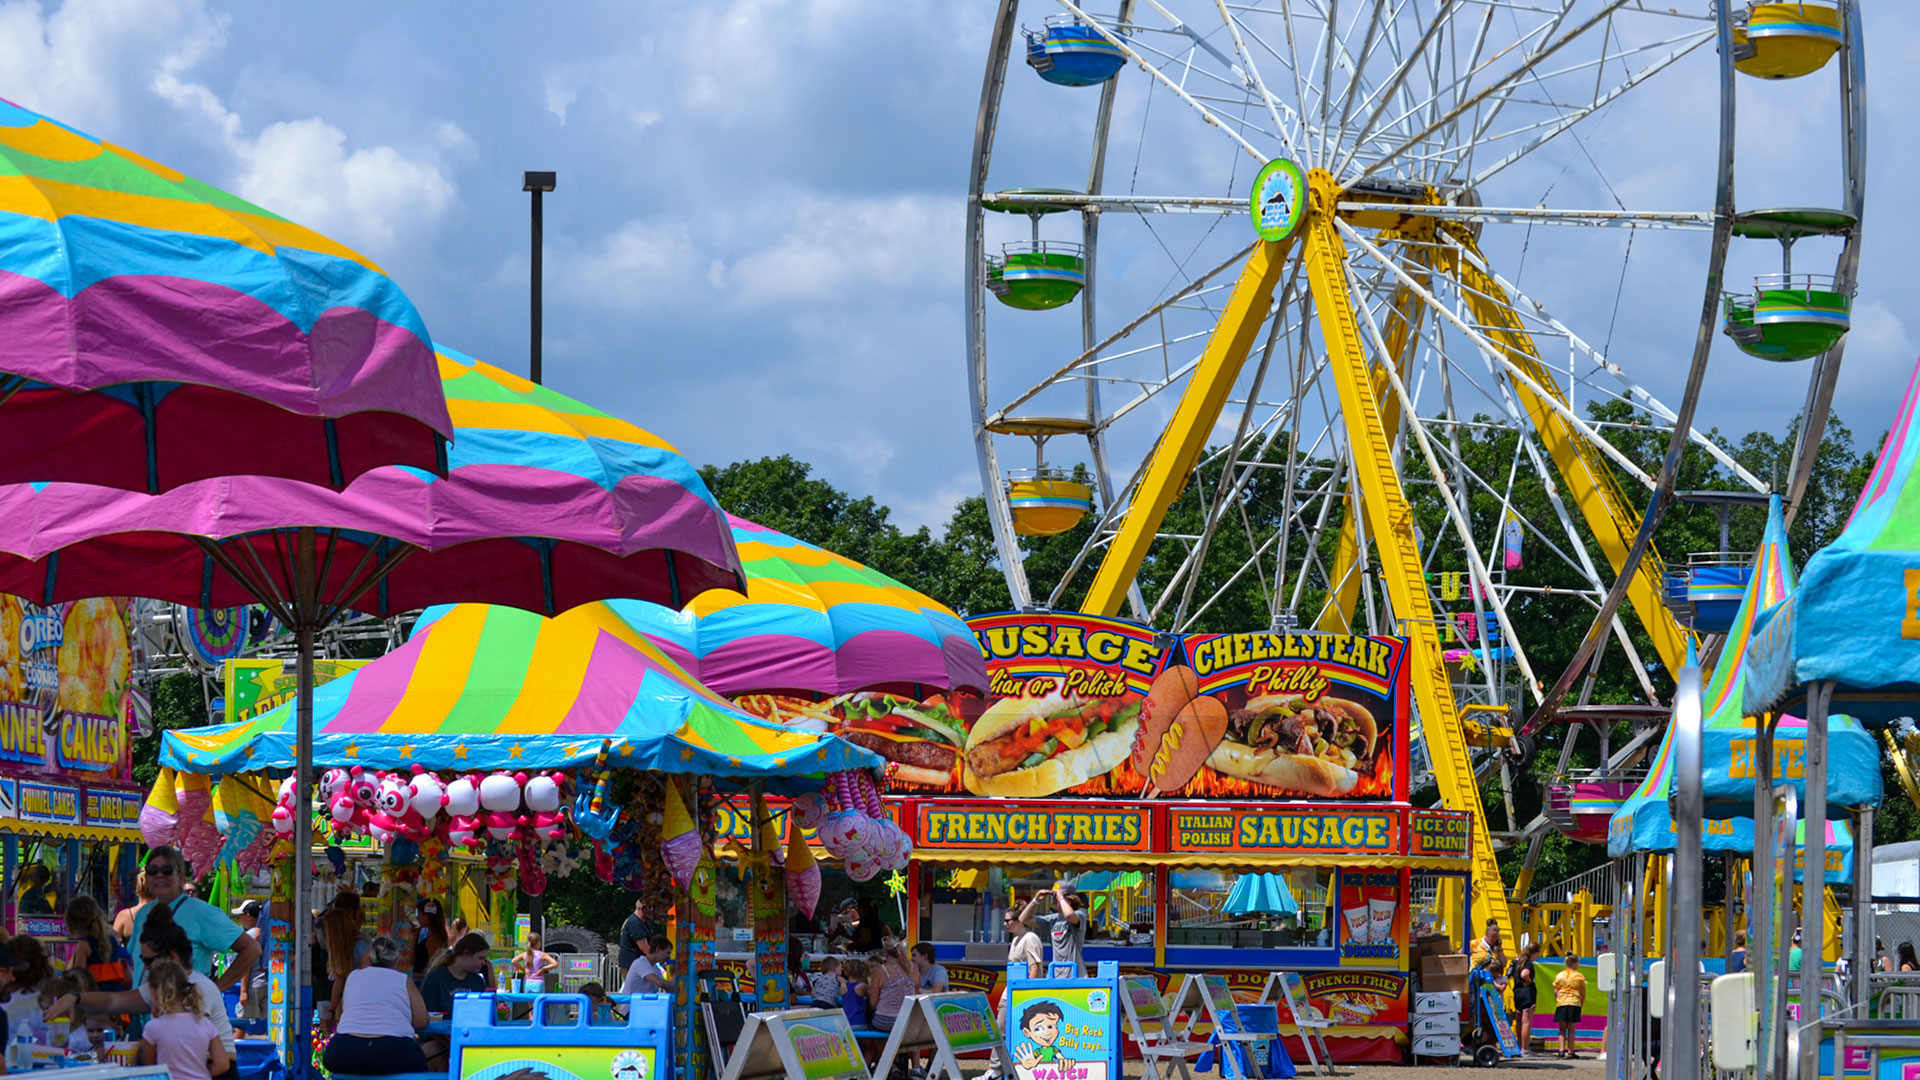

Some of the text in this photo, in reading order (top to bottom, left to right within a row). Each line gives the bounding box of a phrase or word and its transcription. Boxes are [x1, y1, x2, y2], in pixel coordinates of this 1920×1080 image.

[20, 617, 63, 653] OREO
[976, 625, 1160, 674] USAGE
[1194, 634, 1390, 675] CHEESESTEAK
[990, 668, 1126, 697] lian or Polish
[1248, 666, 1327, 700] Philly
[0, 703, 119, 765] NNEL CAKES
[22, 787, 76, 817] FUNNEL CAKES
[100, 795, 122, 820] OREO
[929, 812, 1138, 843] FRENCH FRIES
[1179, 815, 1233, 829] ITALIAN
[1415, 818, 1444, 832] ICE
[1181, 832, 1231, 846] POLISH
[1241, 816, 1387, 847] SAUSAGE
[1422, 835, 1466, 850] DRINK
[1343, 873, 1399, 886] ICE COLD
[757, 929, 785, 942] PICK
[758, 953, 786, 963] LUCKY
[1344, 944, 1394, 957] DRINKS
[761, 962, 785, 976] ONE
[947, 968, 990, 986] STEAK
[1309, 974, 1399, 992] FRENCH FRIES
[1065, 1023, 1103, 1037] Big Rock
[1059, 1036, 1079, 1051] Billy
